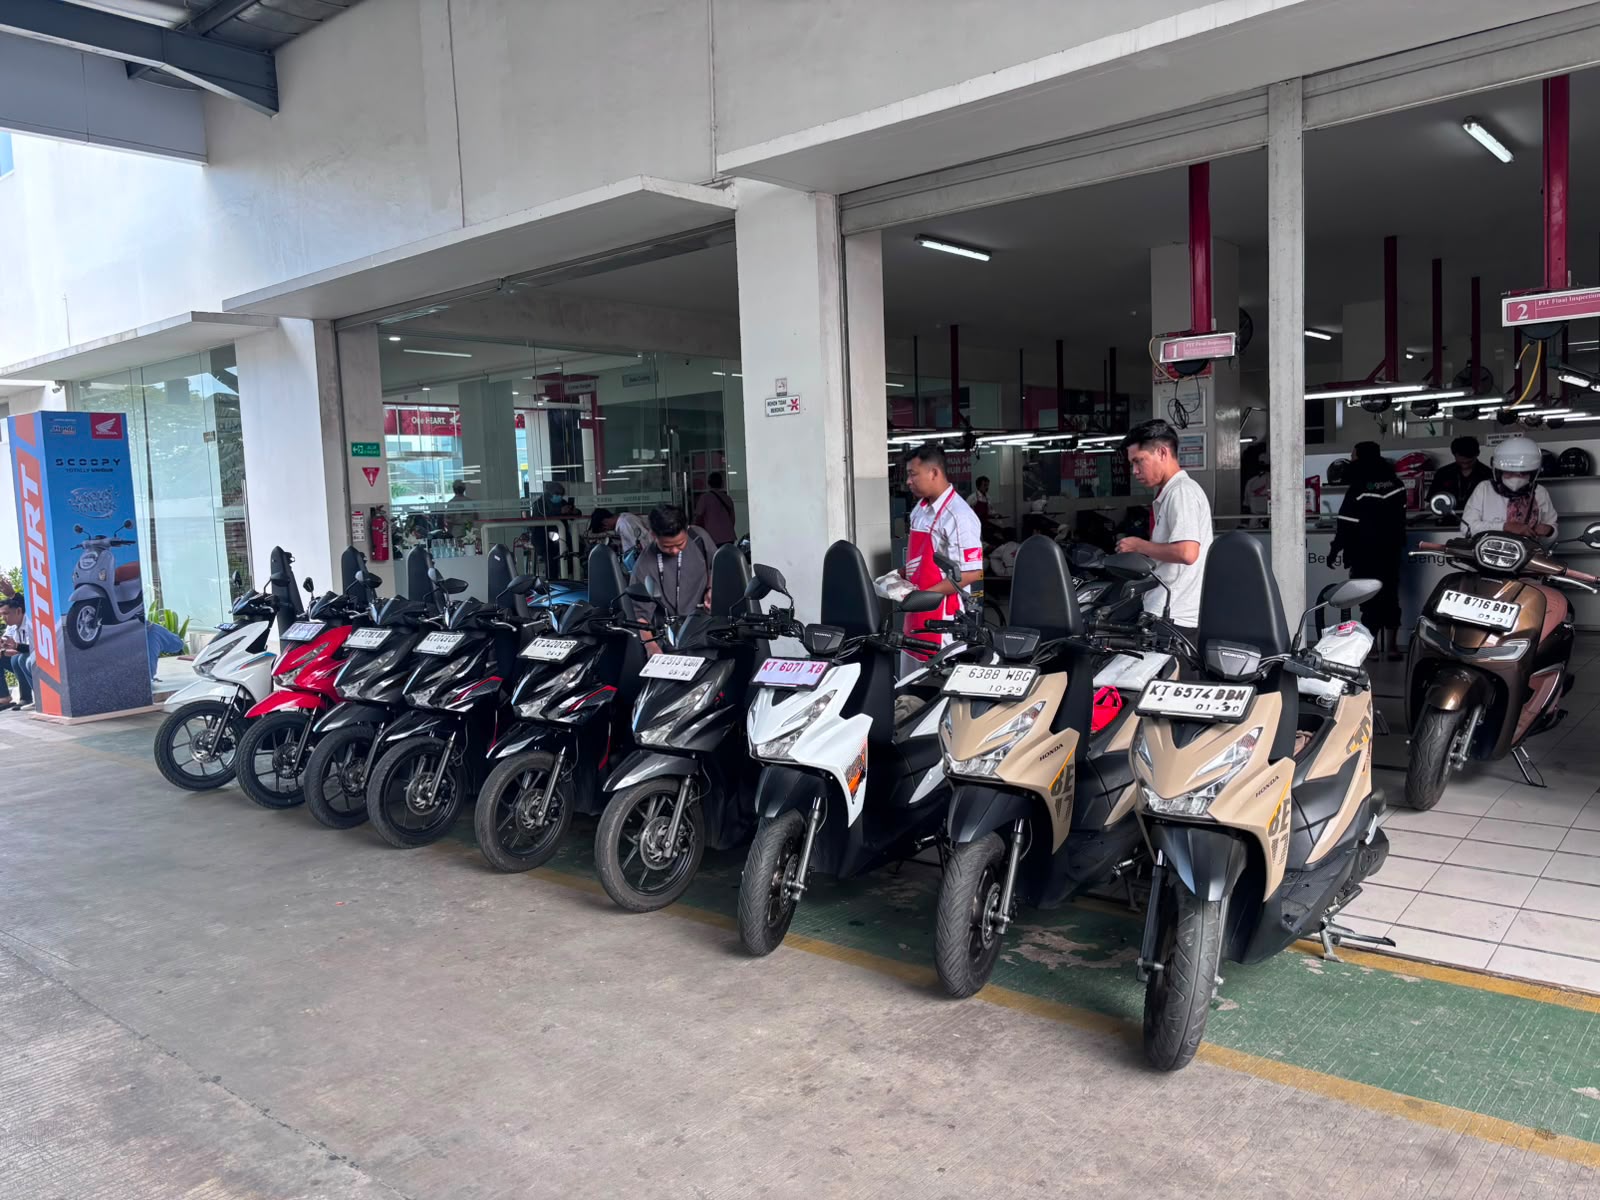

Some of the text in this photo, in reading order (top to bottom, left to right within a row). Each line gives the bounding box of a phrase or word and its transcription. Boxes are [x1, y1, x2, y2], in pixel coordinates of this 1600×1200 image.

[1516, 304, 1529, 321] 2
[1172, 344, 1178, 358] 1
[55, 458, 121, 466] SCOOPY
[21, 463, 56, 666] START
[1445, 592, 1461, 603] KT
[650, 655, 664, 664] KT
[1222, 651, 1246, 660] HONDA
[762, 661, 824, 674] KT 6071 XB
[952, 666, 964, 677] F
[968, 667, 1002, 680] 6388
[1149, 684, 1171, 696] KT
[1172, 686, 1214, 700] 6574
[1039, 743, 1064, 762] HONDA
[1255, 775, 1280, 798] HONDA
